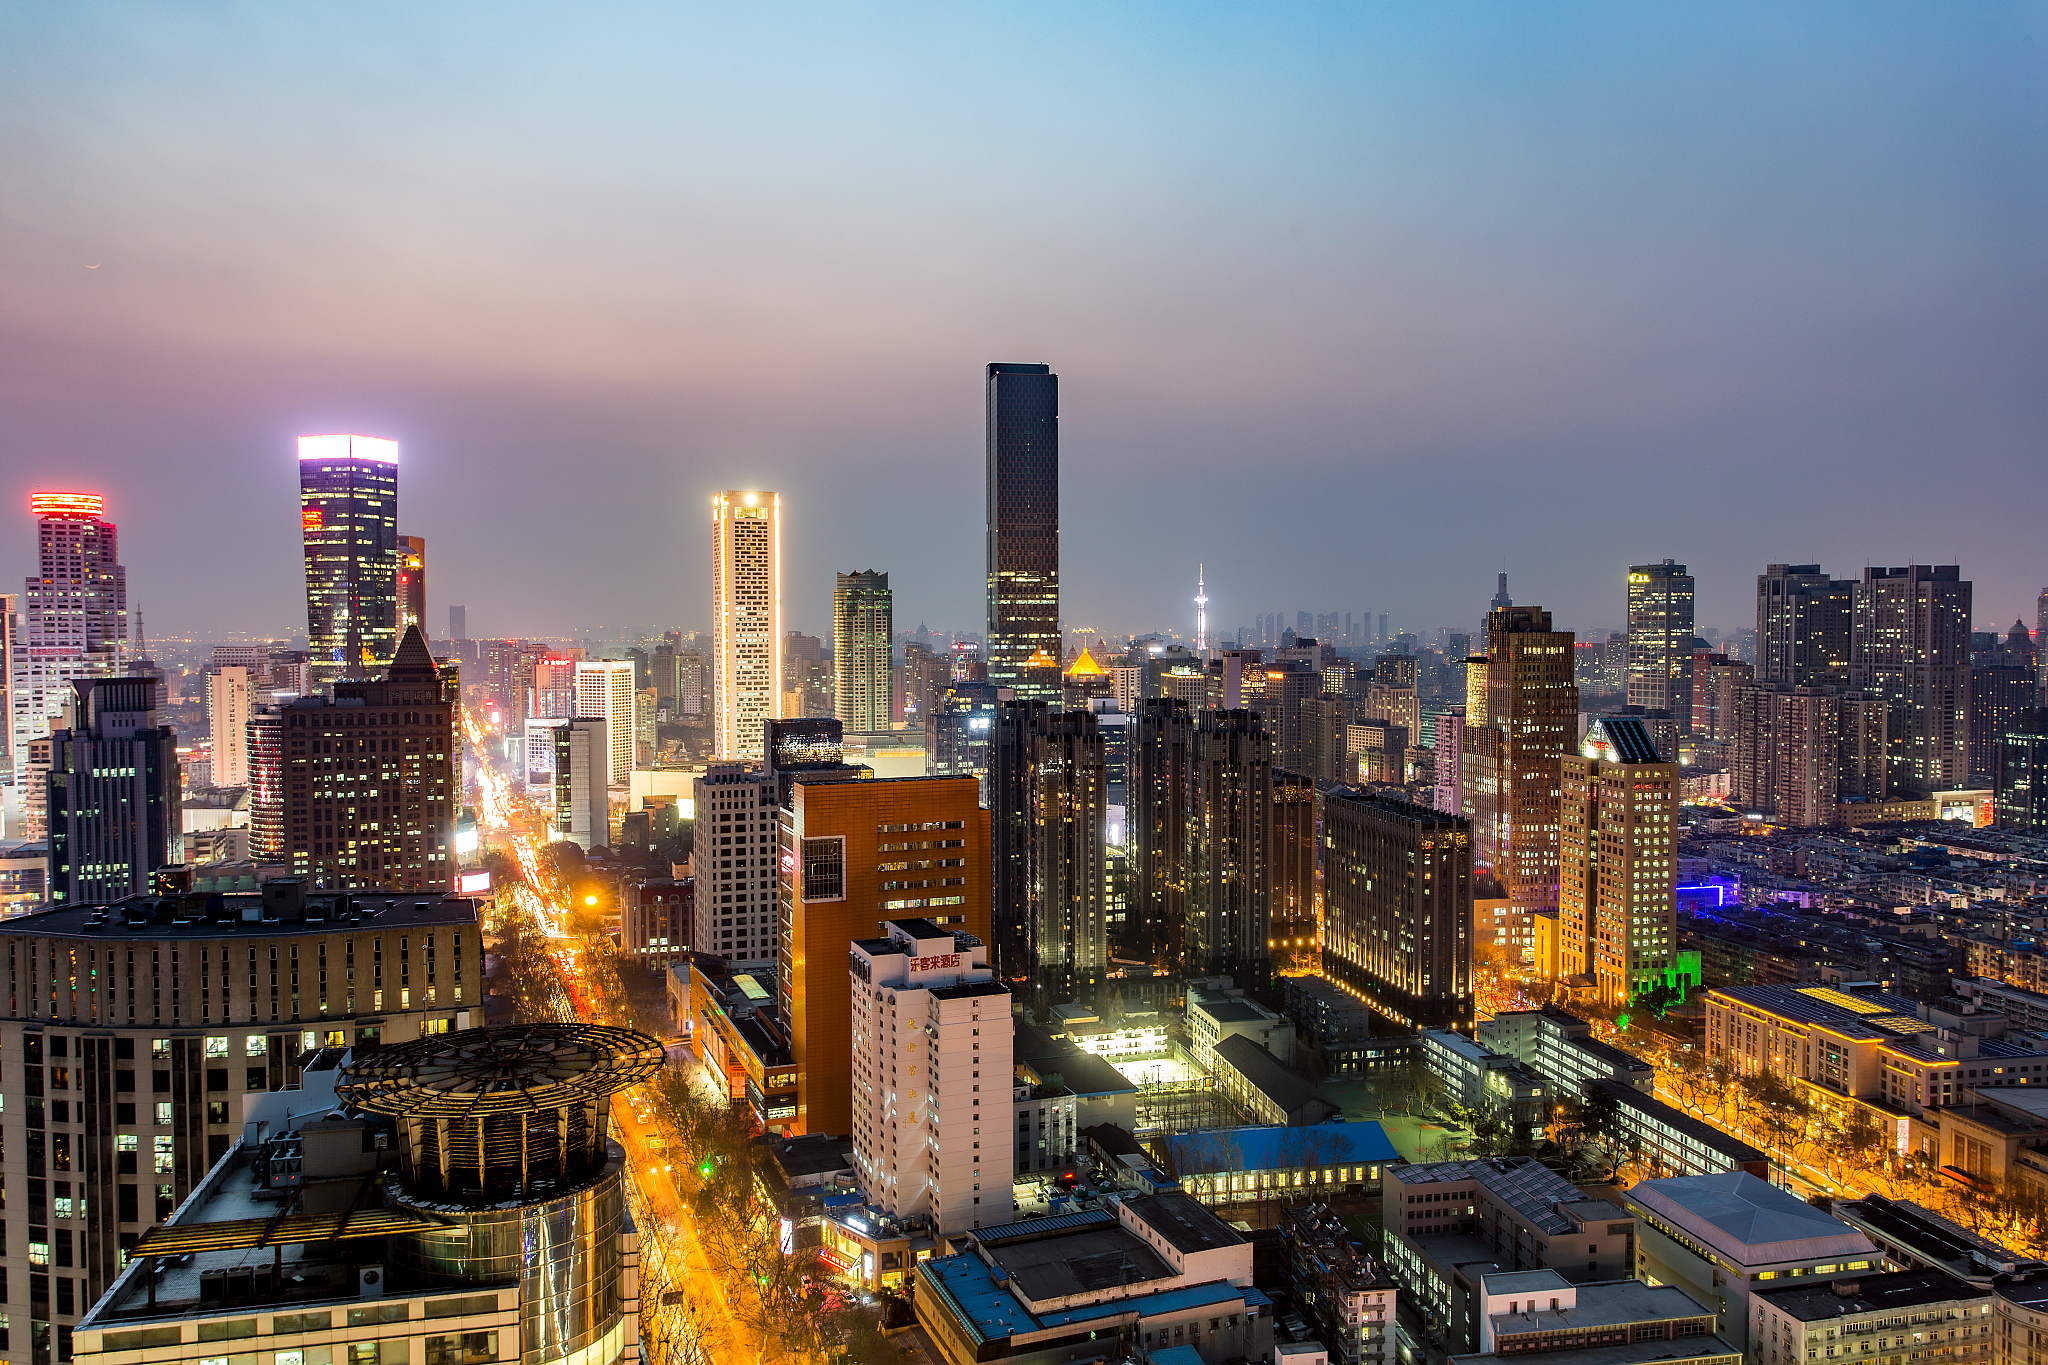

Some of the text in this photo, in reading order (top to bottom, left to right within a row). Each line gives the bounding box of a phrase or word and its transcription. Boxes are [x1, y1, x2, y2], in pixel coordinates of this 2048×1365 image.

[392, 690, 432, 700] 华泰证券
[910, 954, 960, 972] 乐客来酒店
